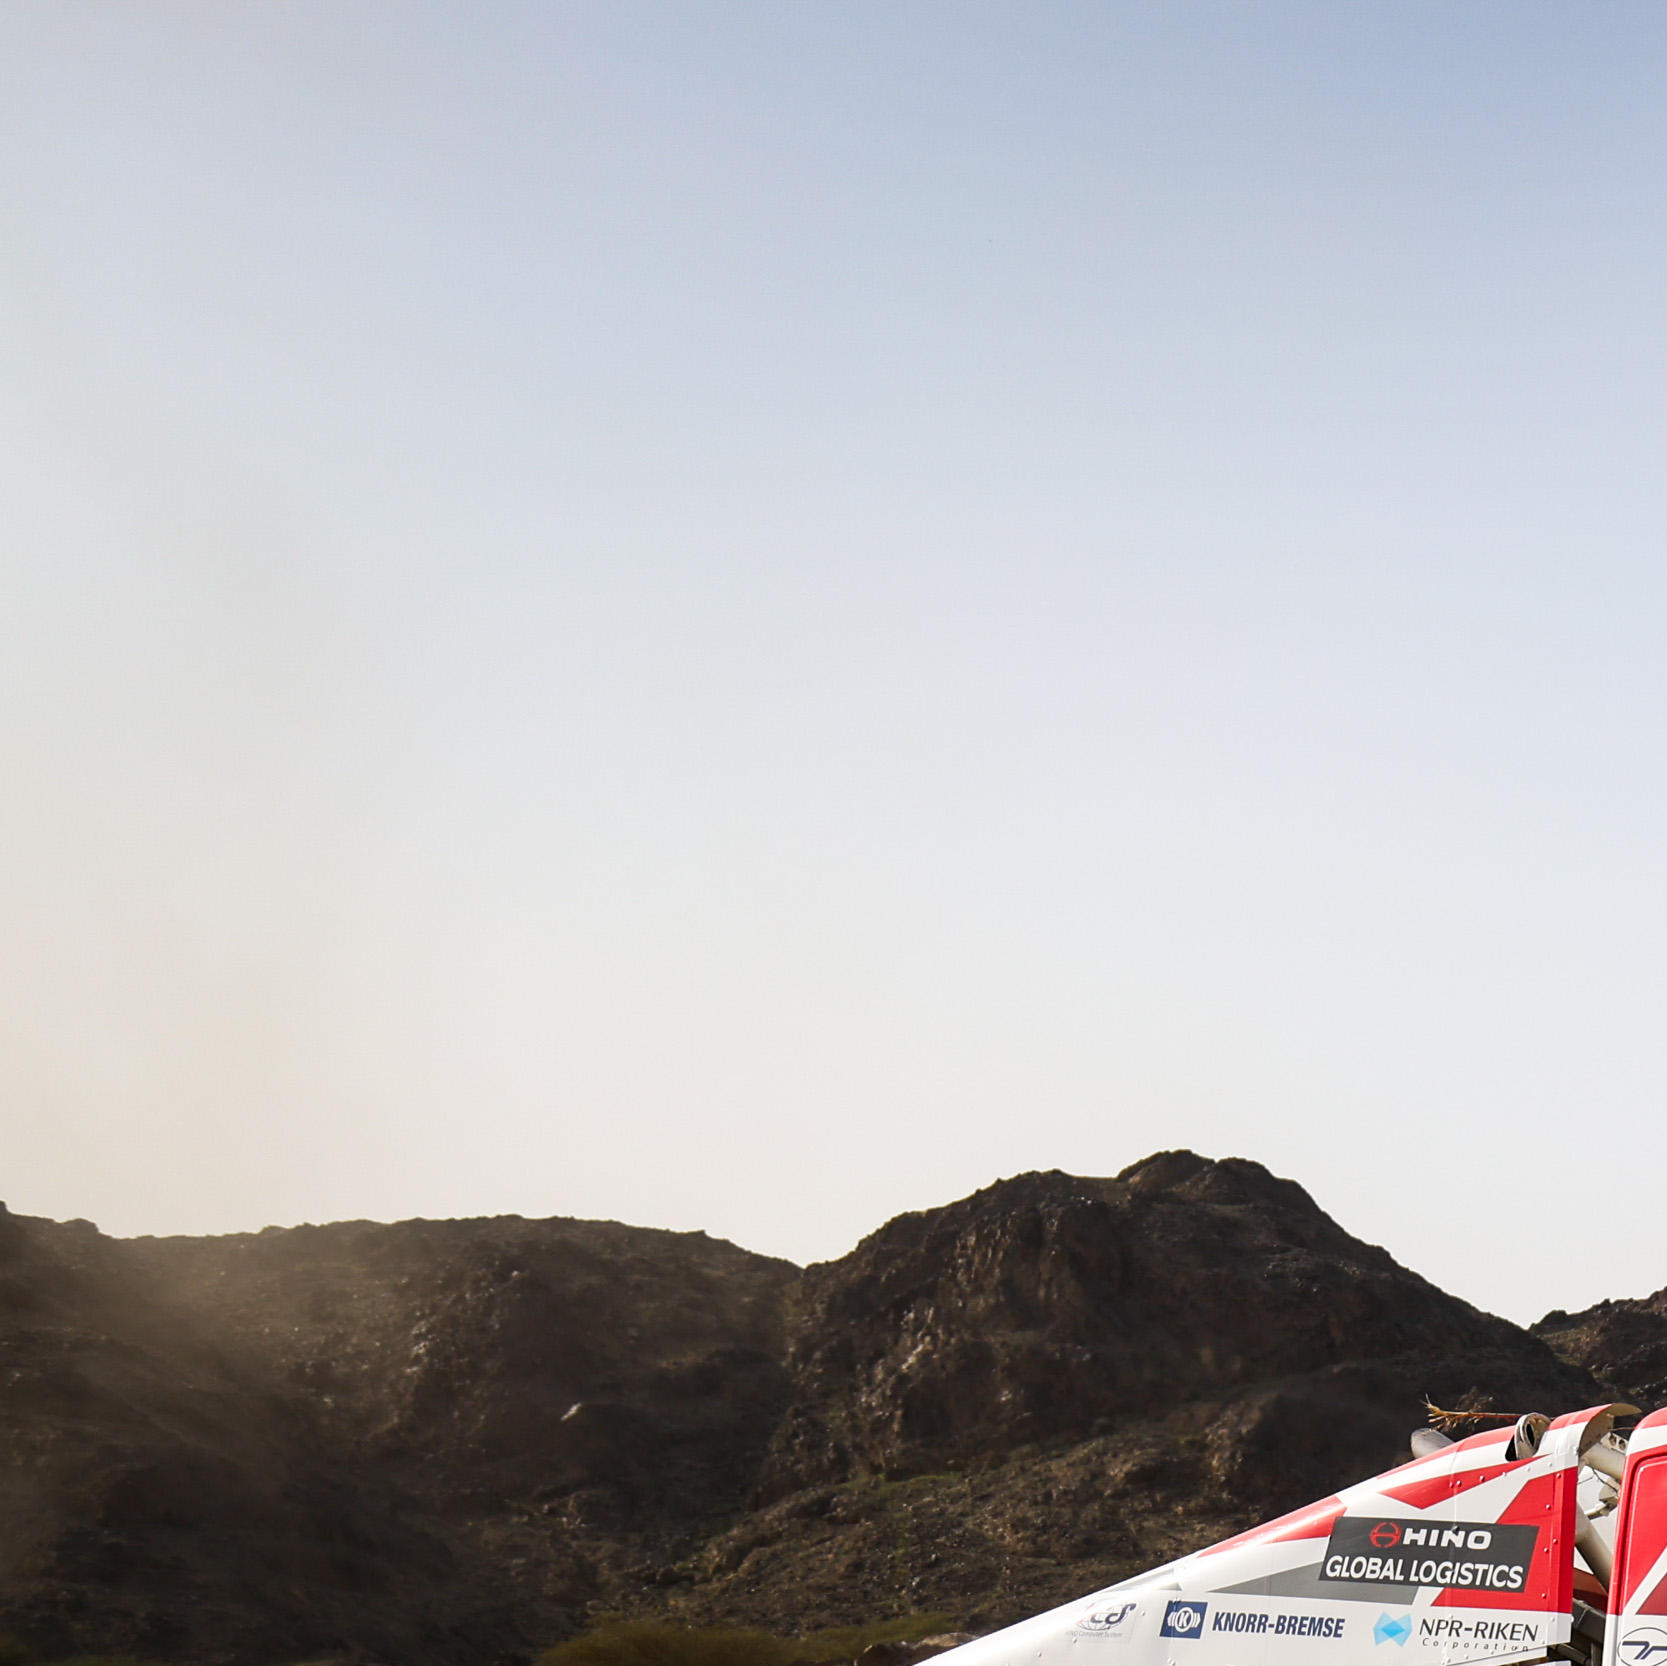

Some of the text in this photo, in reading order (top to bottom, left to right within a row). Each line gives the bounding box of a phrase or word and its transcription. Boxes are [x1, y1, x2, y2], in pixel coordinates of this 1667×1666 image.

[1403, 1527, 1492, 1550] HINO
[1326, 1556, 1524, 1589] GLOBAL LOGISTICS
[1213, 1611, 1346, 1638] KNORR-BREMSE
[1419, 1618, 1539, 1642] NPR-RIKEN
[1422, 1637, 1529, 1652] Corporation
